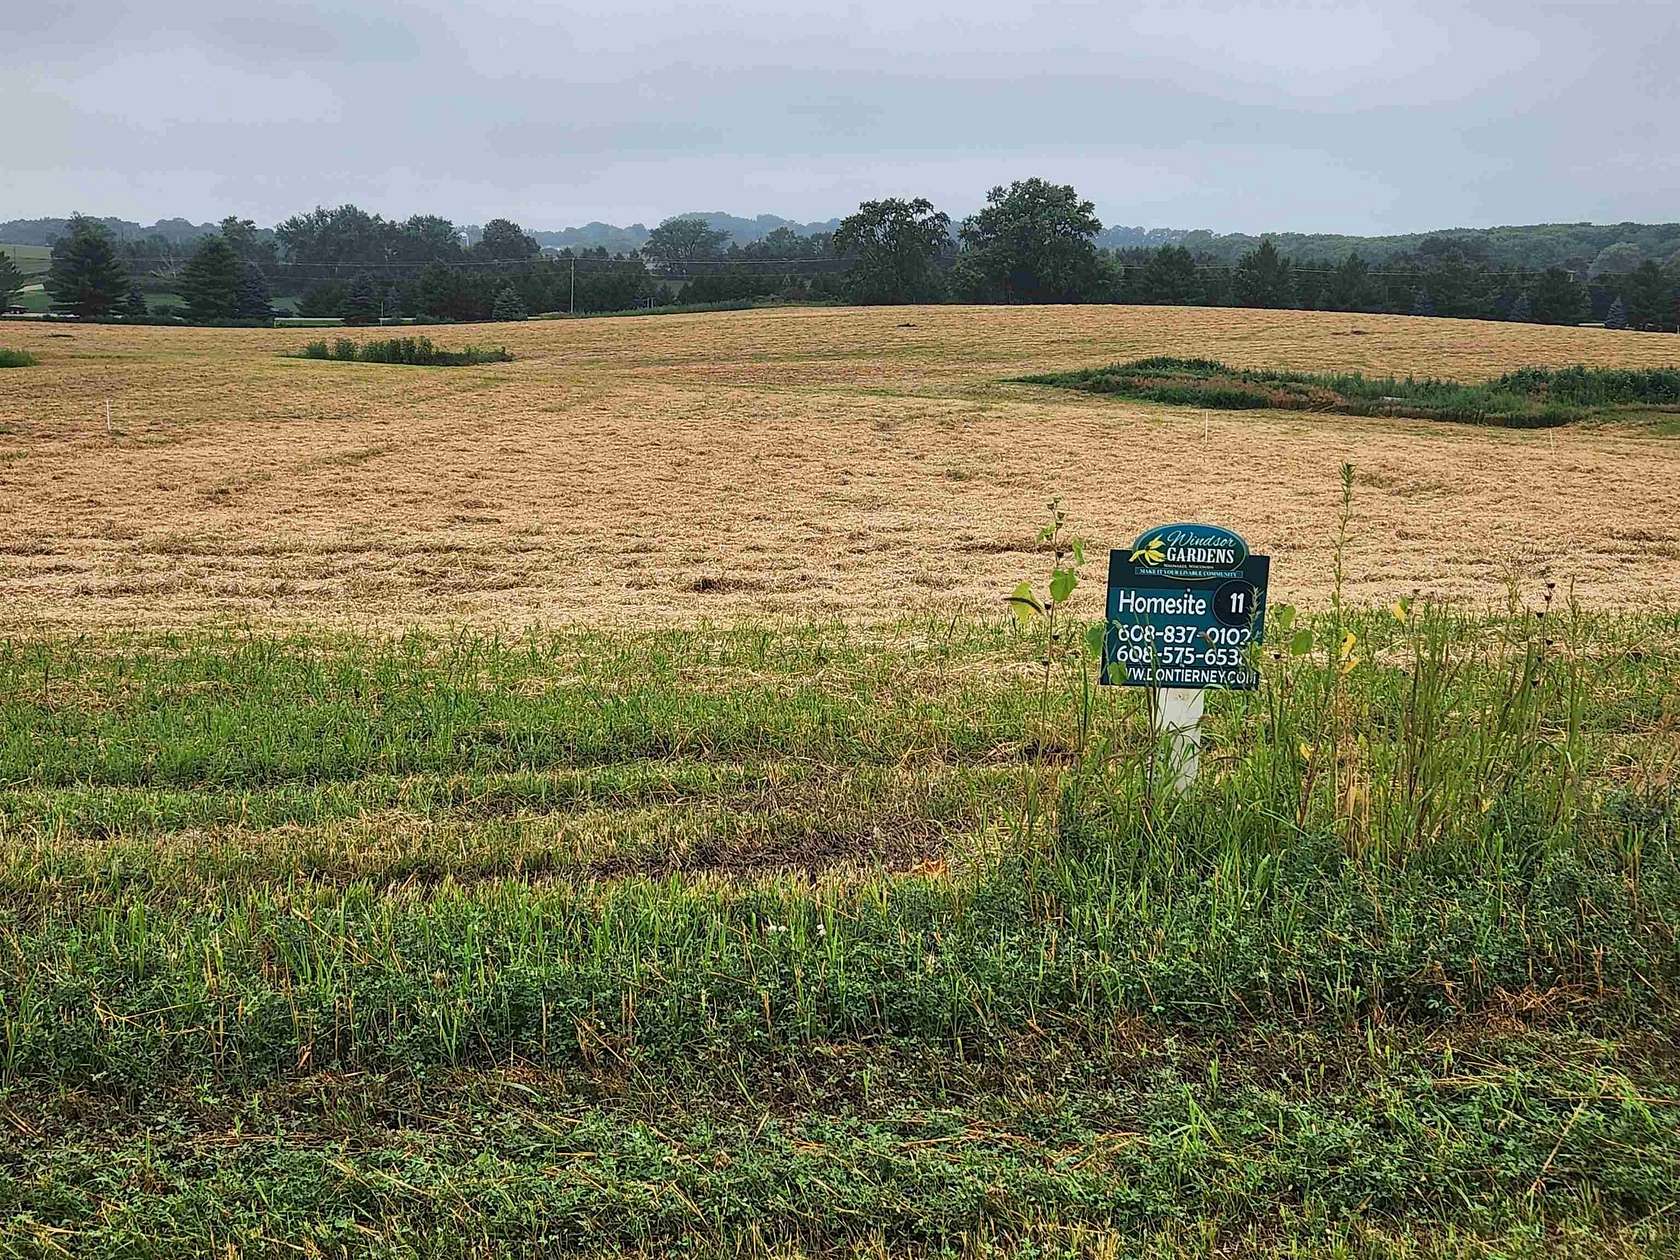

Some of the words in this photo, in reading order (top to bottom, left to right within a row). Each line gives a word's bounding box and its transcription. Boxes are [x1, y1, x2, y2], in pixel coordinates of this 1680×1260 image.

[1167, 530, 1236, 547] Windsor
[1167, 547, 1234, 564] GARDENS
[1118, 588, 1207, 615] Homesite
[1230, 592, 1245, 613] 11
[1118, 624, 1251, 646] 608-837-0102
